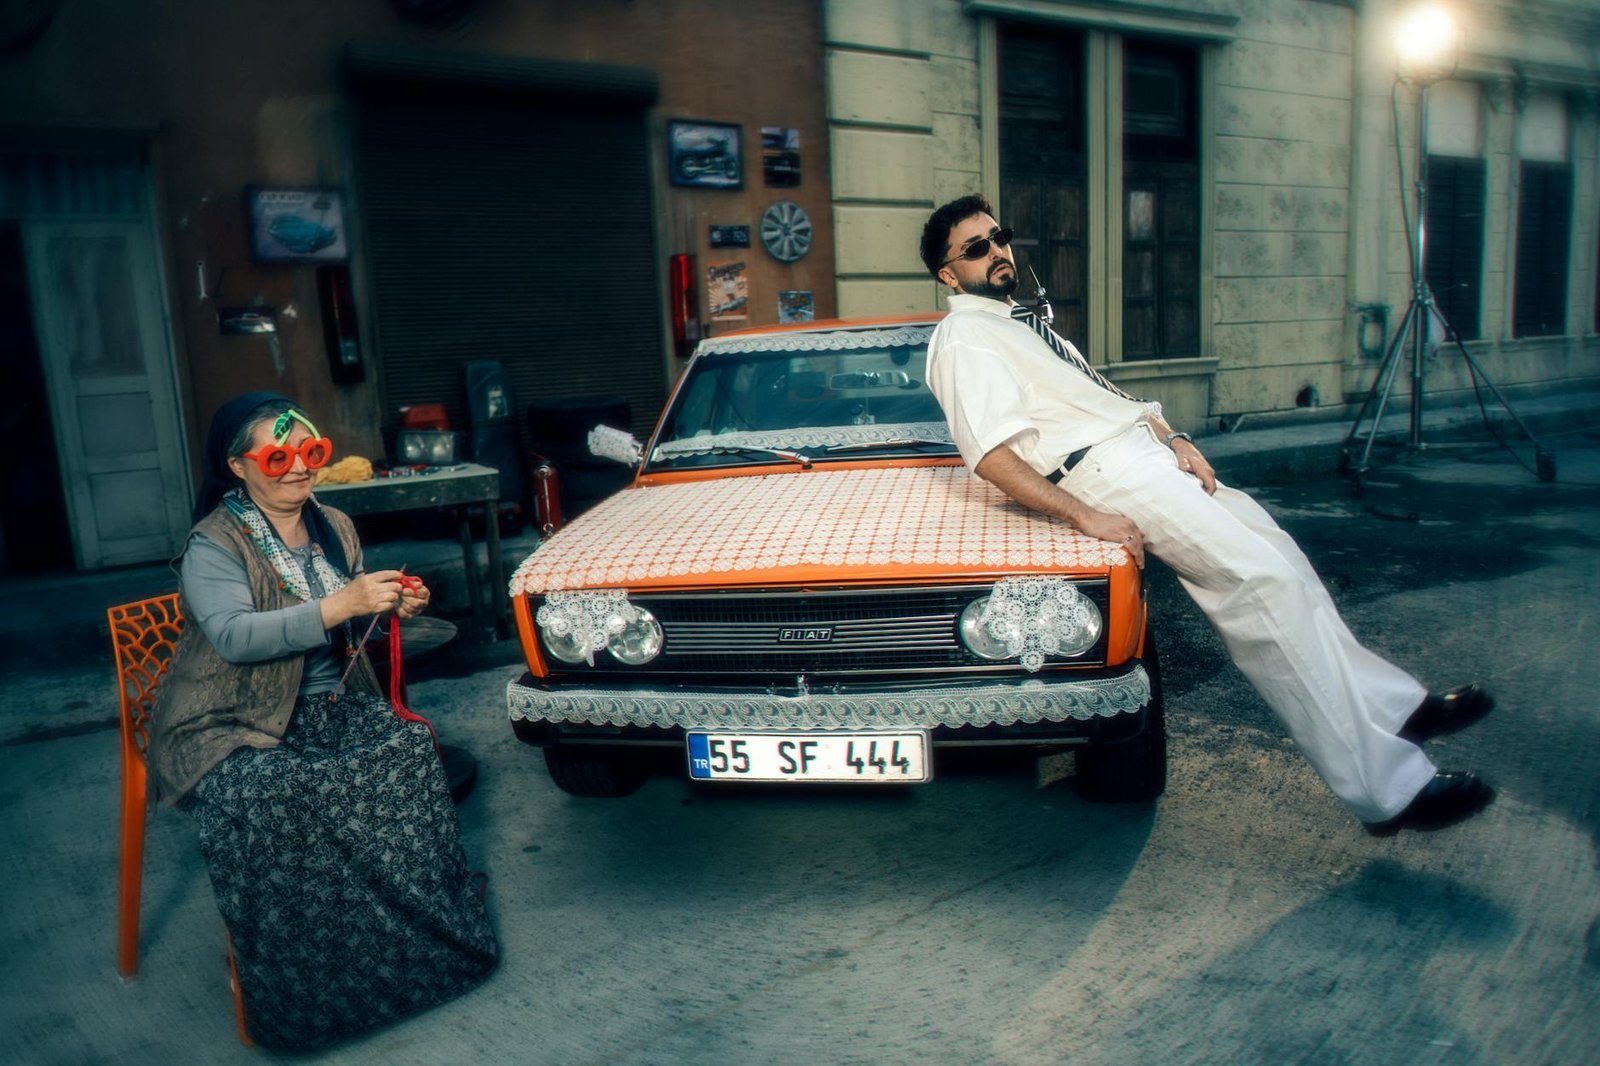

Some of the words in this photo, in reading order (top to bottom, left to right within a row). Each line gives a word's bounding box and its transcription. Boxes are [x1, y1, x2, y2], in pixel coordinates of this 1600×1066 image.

[783, 630, 829, 639] FIAT
[709, 740, 750, 773] 55
[778, 741, 818, 774] SF
[846, 740, 910, 774] 444
[694, 758, 709, 769] TR
